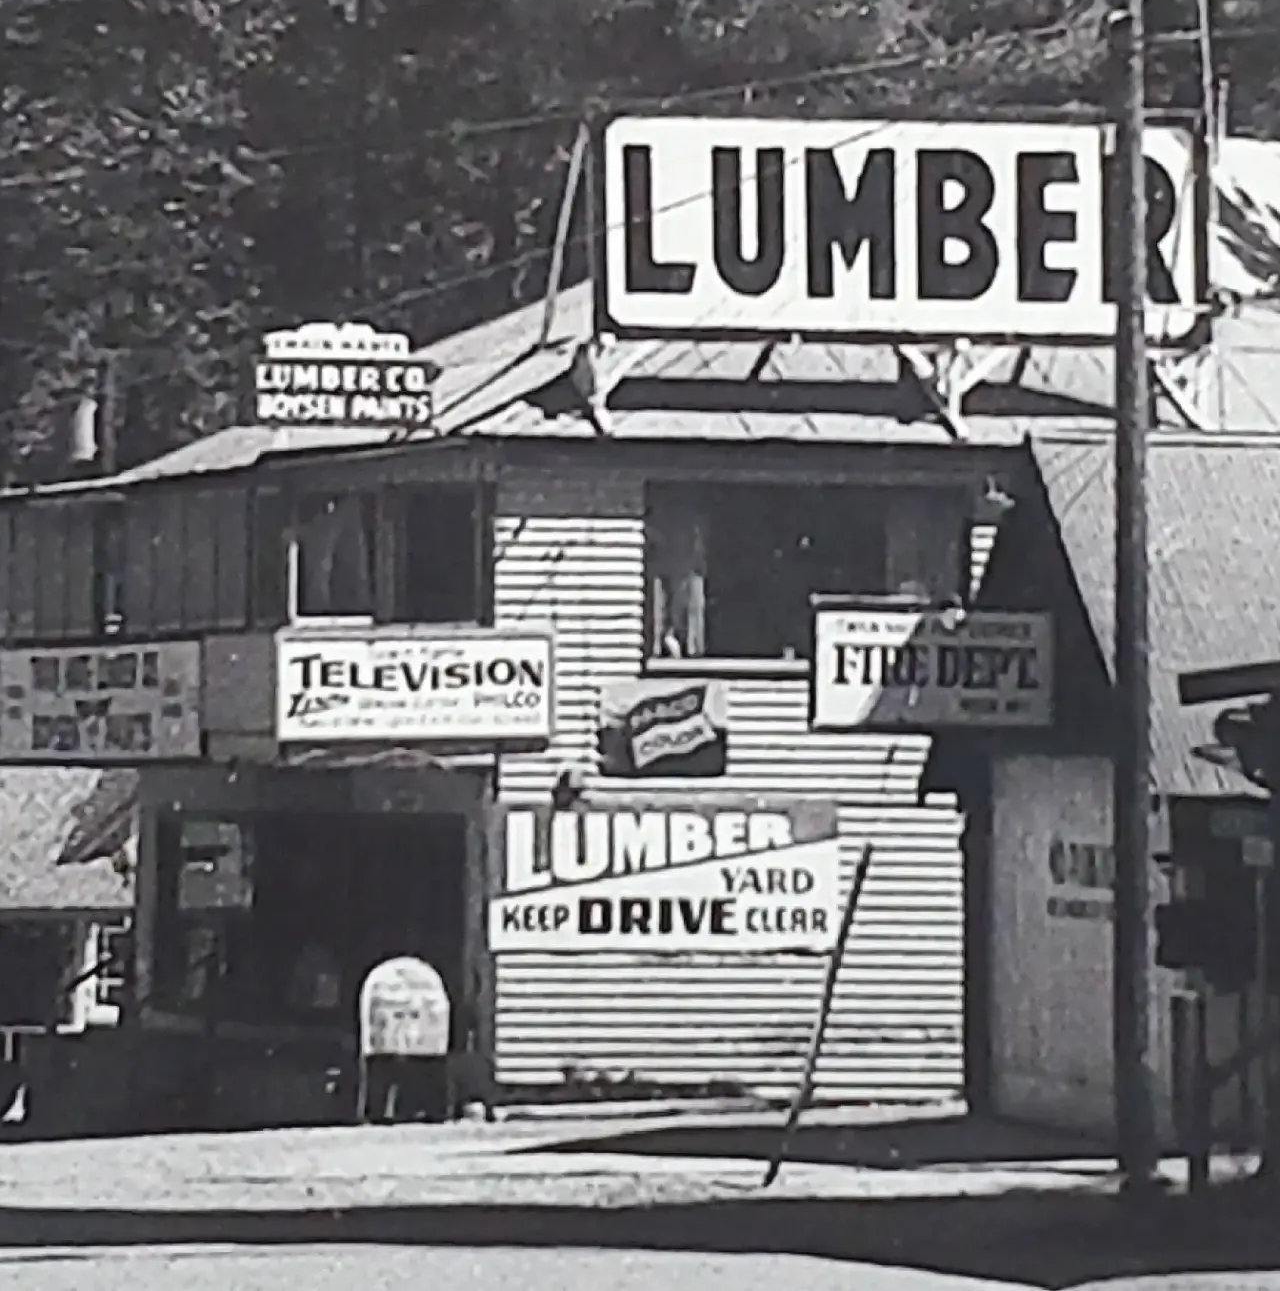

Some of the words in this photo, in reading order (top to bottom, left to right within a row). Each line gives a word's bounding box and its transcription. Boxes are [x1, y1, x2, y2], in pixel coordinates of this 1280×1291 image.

[622, 144, 1182, 304] LUMBER
[256, 363, 382, 392] LUMBER
[289, 653, 544, 692] TELEVISION
[832, 643, 929, 687] FIRE
[505, 809, 794, 892] LUMBER
[720, 865, 816, 895] YARD
[502, 904, 570, 934] KEEP
[578, 896, 737, 935] DRIVE
[746, 906, 829, 934] CLEAR
